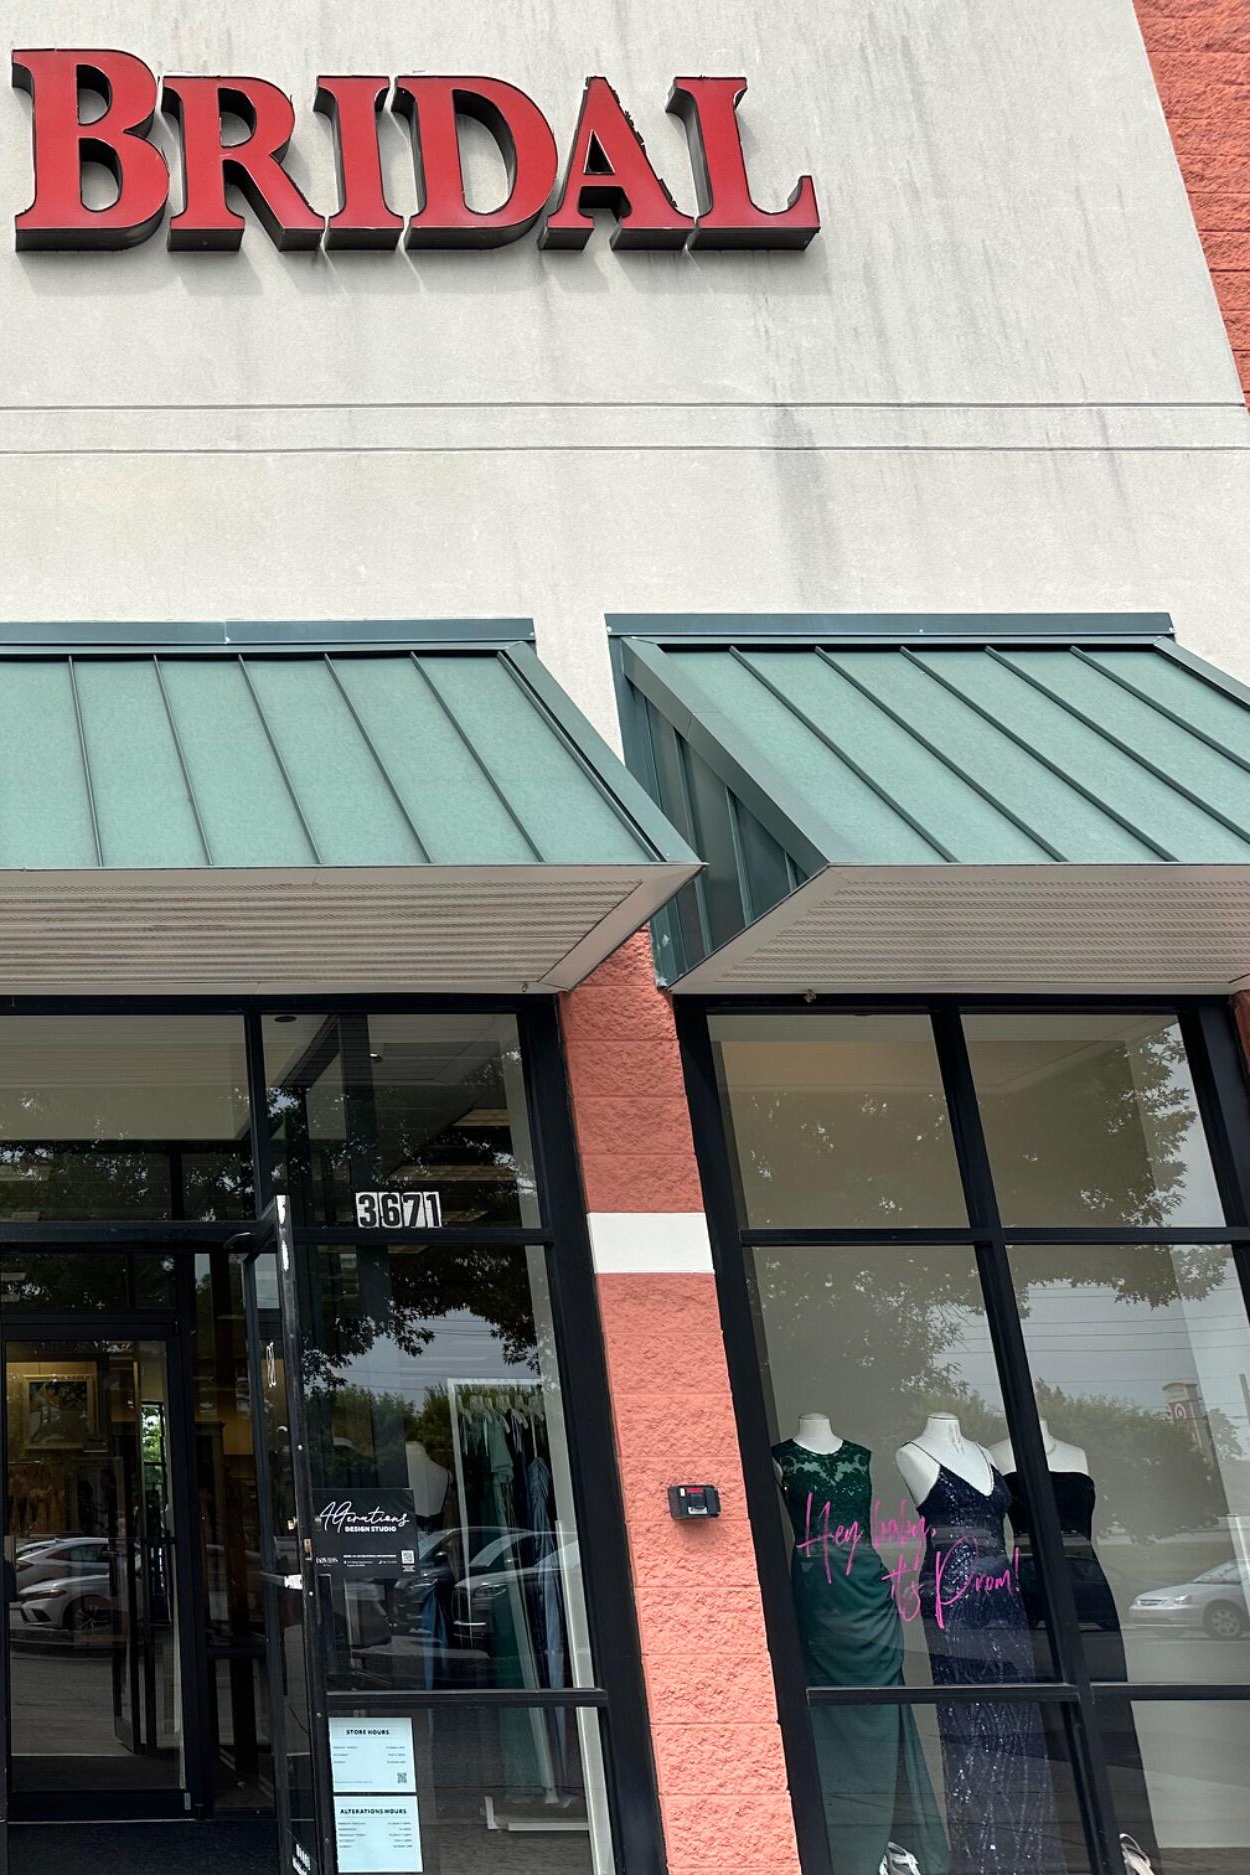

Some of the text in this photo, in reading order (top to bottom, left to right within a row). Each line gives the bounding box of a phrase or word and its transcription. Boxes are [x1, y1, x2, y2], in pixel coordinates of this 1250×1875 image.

[12, 48, 822, 253] BRIDAL
[358, 1193, 440, 1228] 3671
[796, 1492, 864, 1584] Hey
